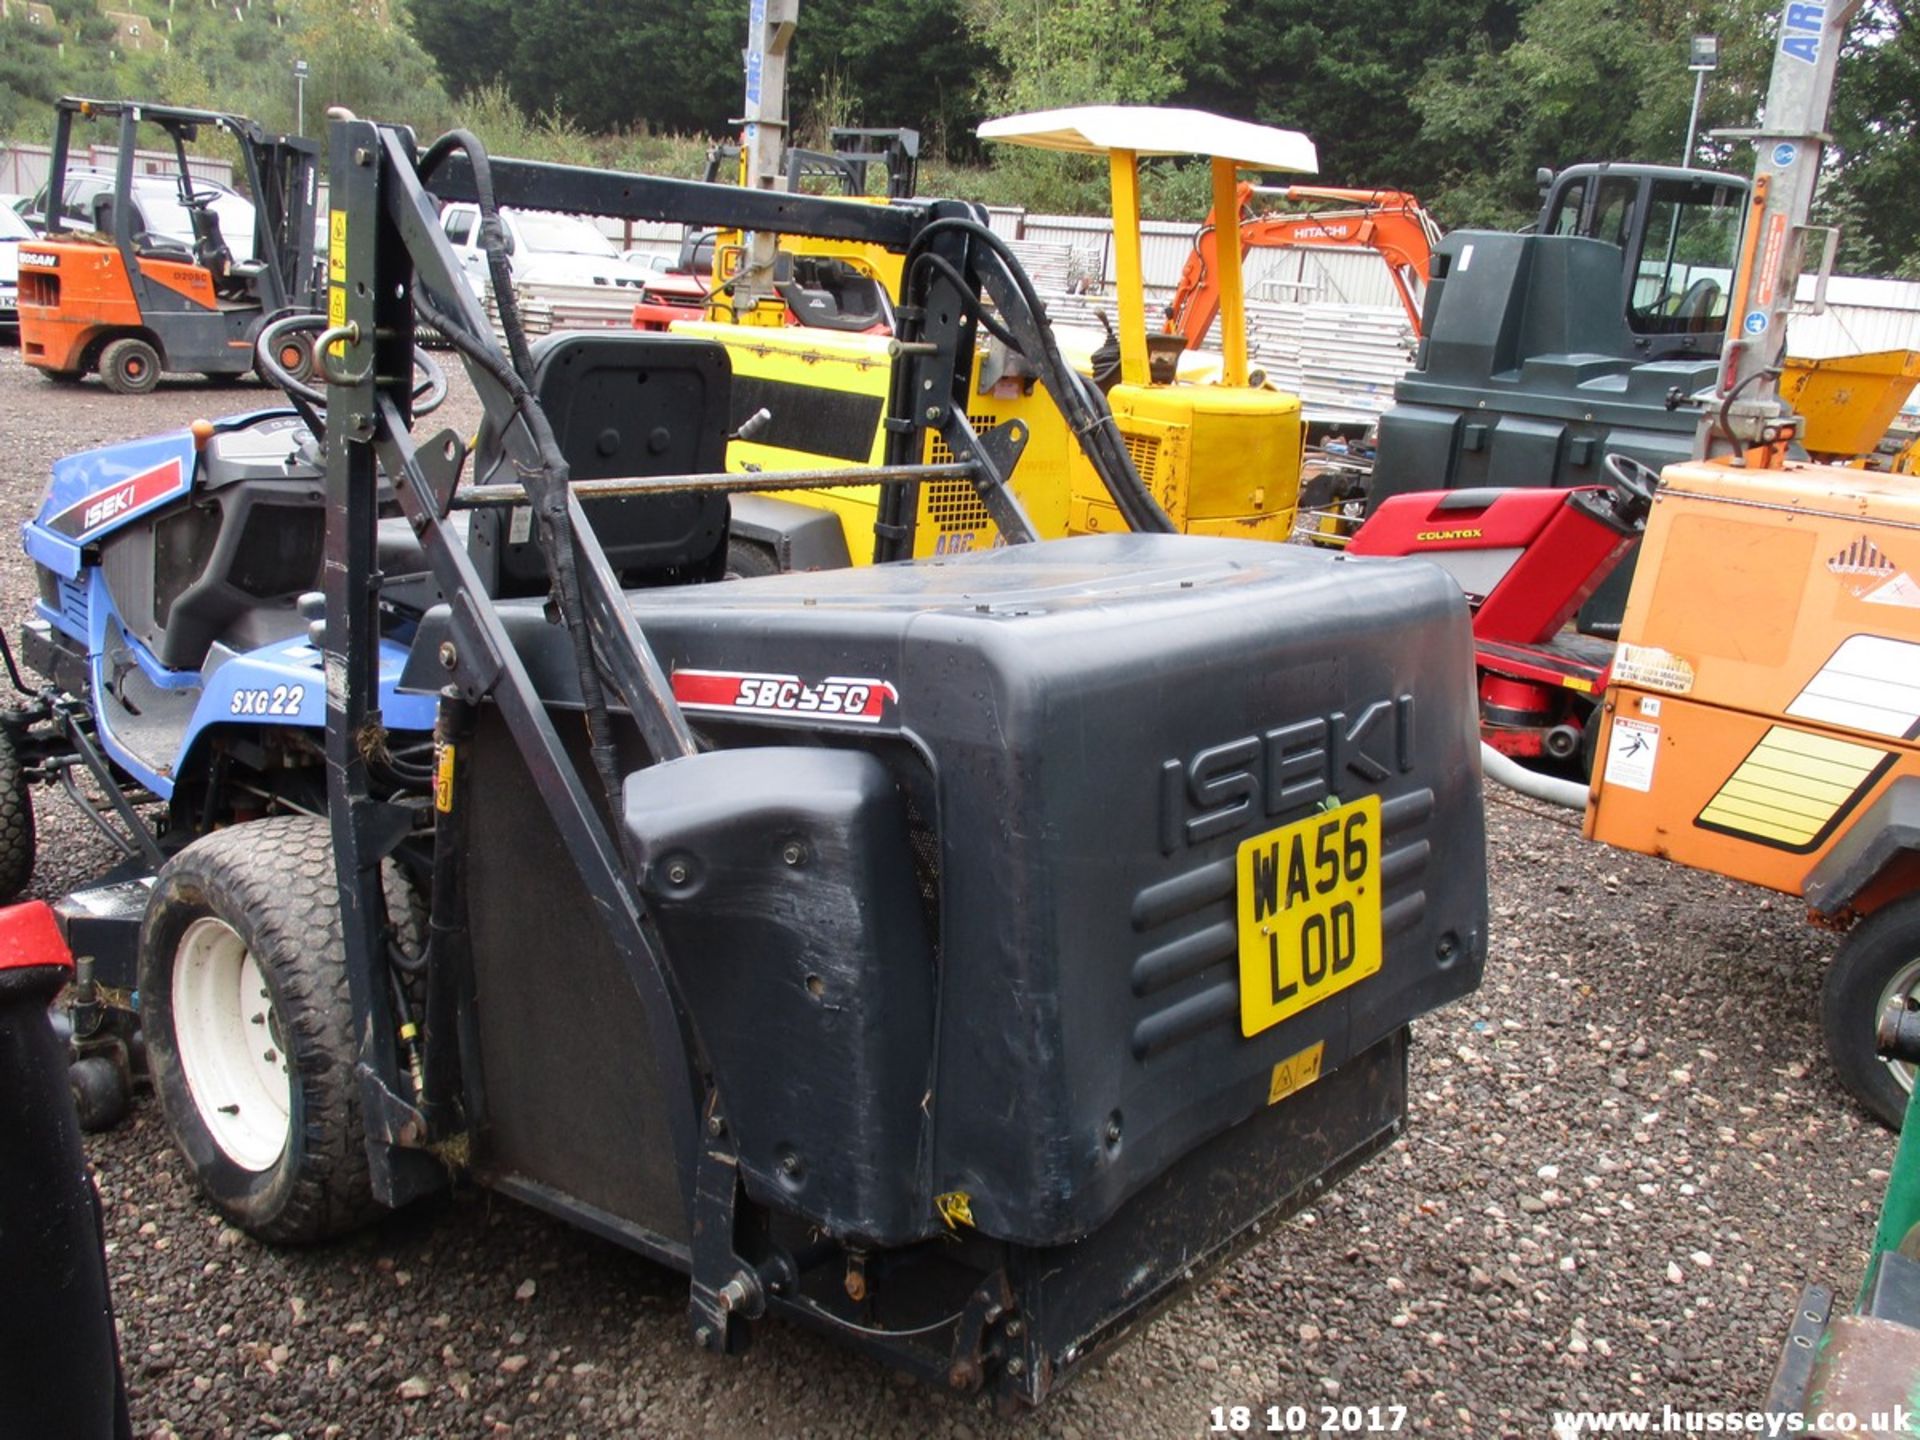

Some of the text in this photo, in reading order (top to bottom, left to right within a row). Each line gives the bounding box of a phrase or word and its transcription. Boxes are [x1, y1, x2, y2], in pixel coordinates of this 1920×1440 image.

[1294, 225, 1347, 239] HITACHI
[84, 484, 135, 529] ISEKI
[231, 683, 305, 716] SXG22
[1160, 694, 1414, 857] ISEKI
[1252, 810, 1368, 923] WA56
[1268, 899, 1357, 1007] LOD
